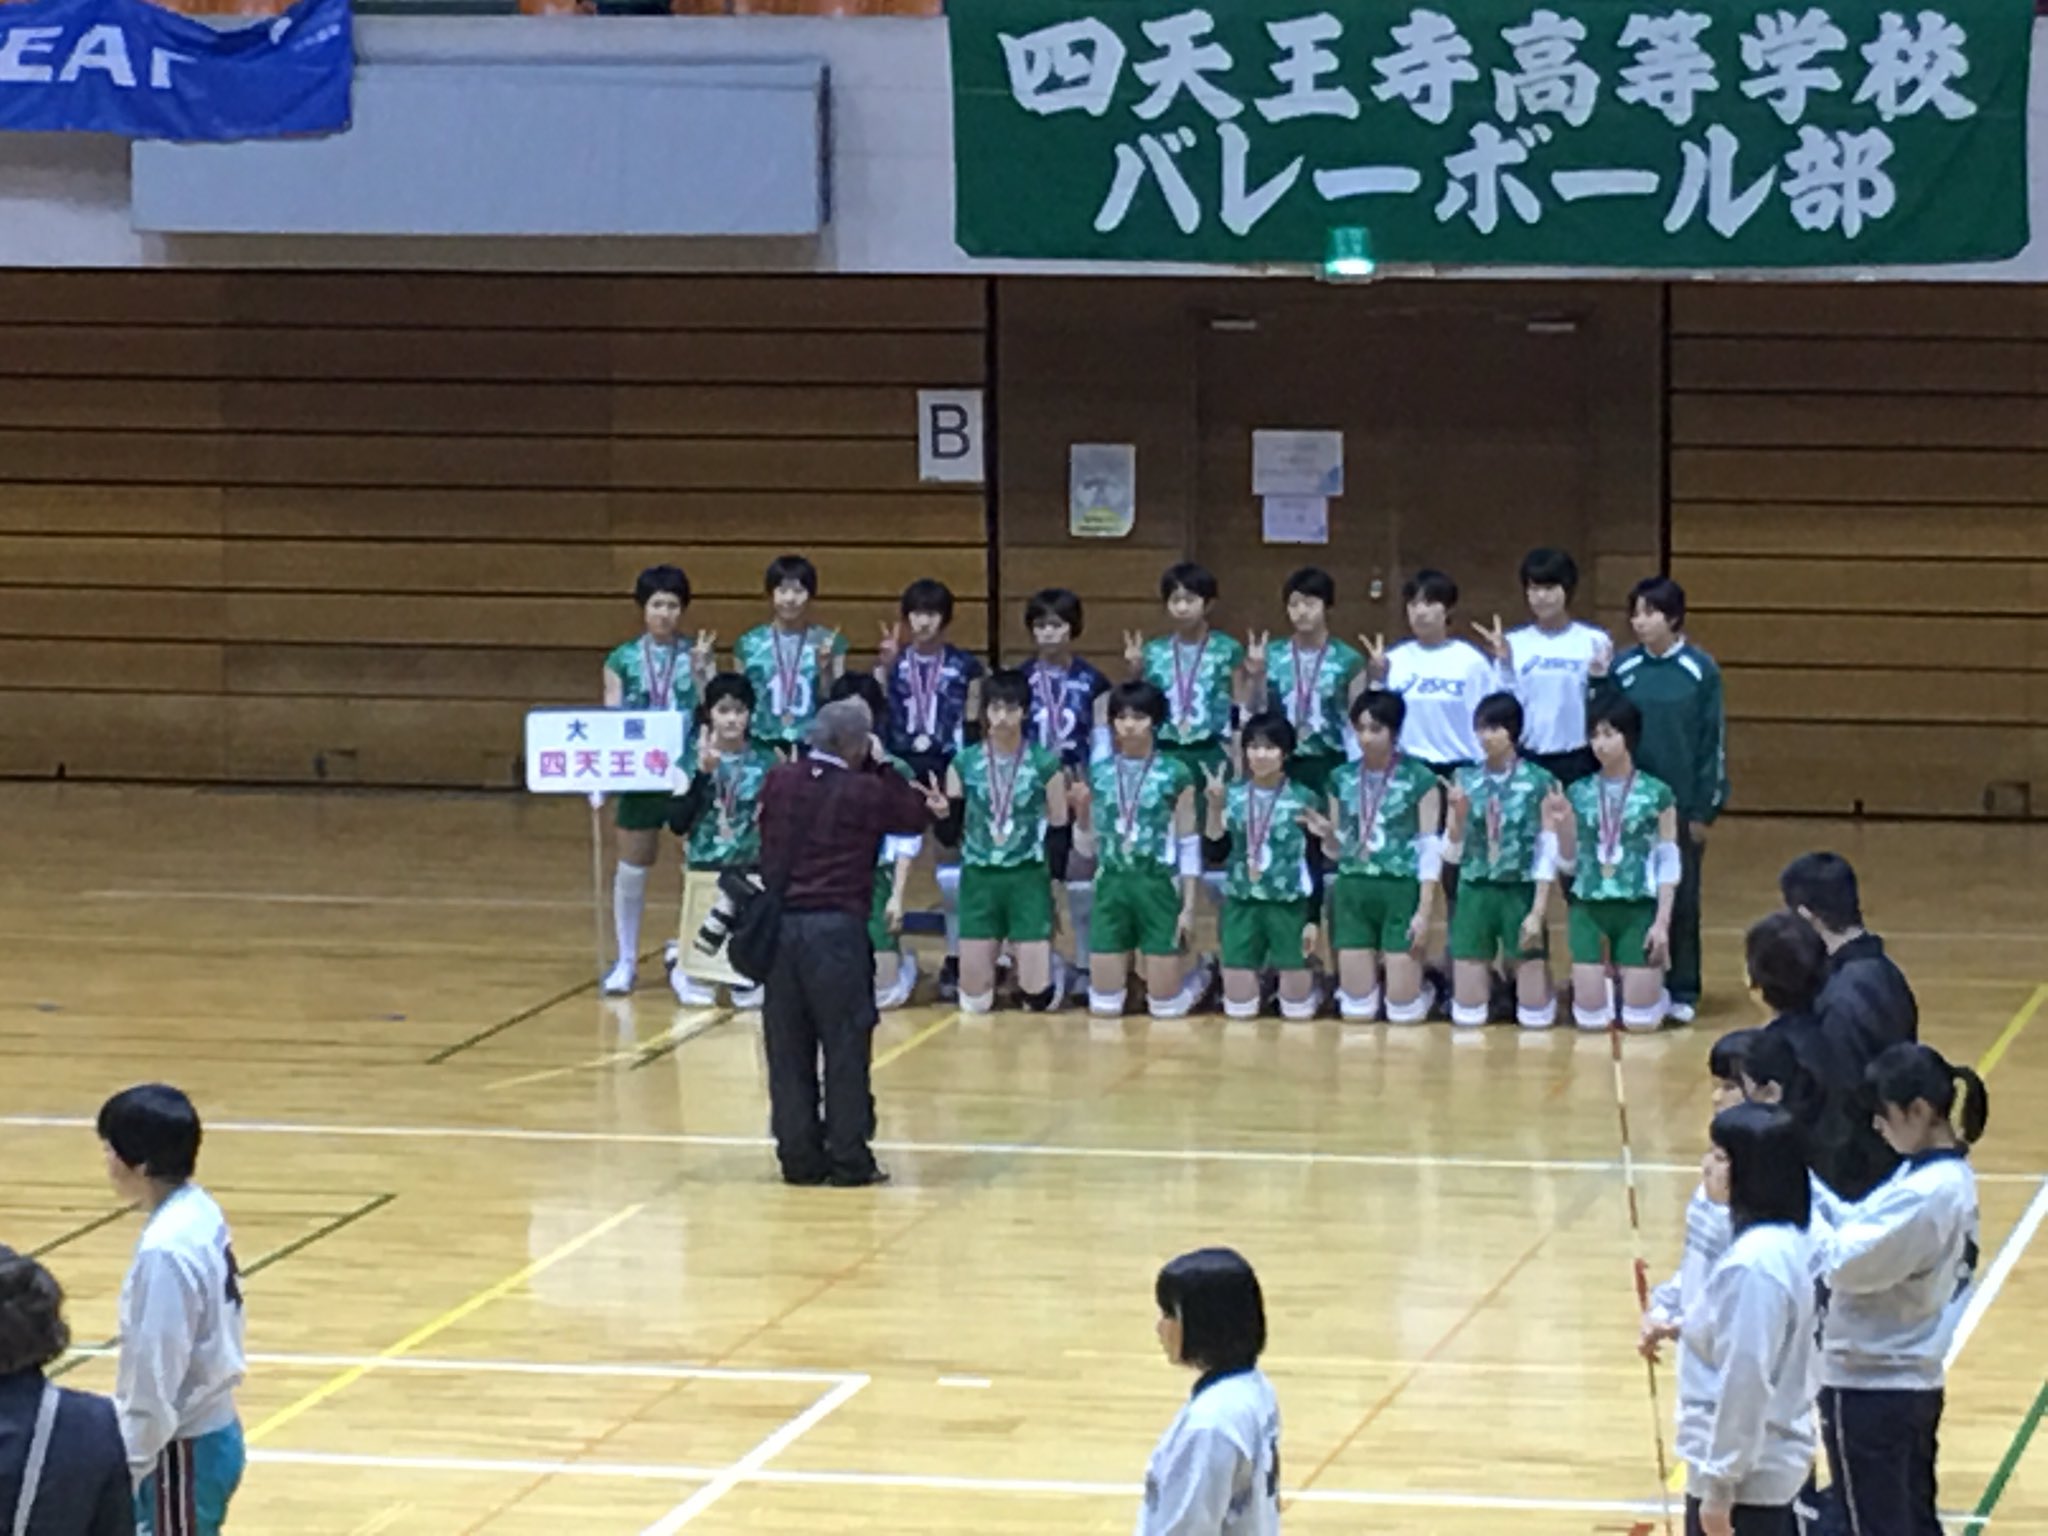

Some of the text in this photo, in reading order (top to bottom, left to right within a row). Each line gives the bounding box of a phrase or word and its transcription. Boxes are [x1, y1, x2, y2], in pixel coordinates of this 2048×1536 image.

[1000, 9, 1976, 125] 四天王寺高等学校
[1096, 123, 1895, 237] バレーボール部
[929, 403, 970, 459] B
